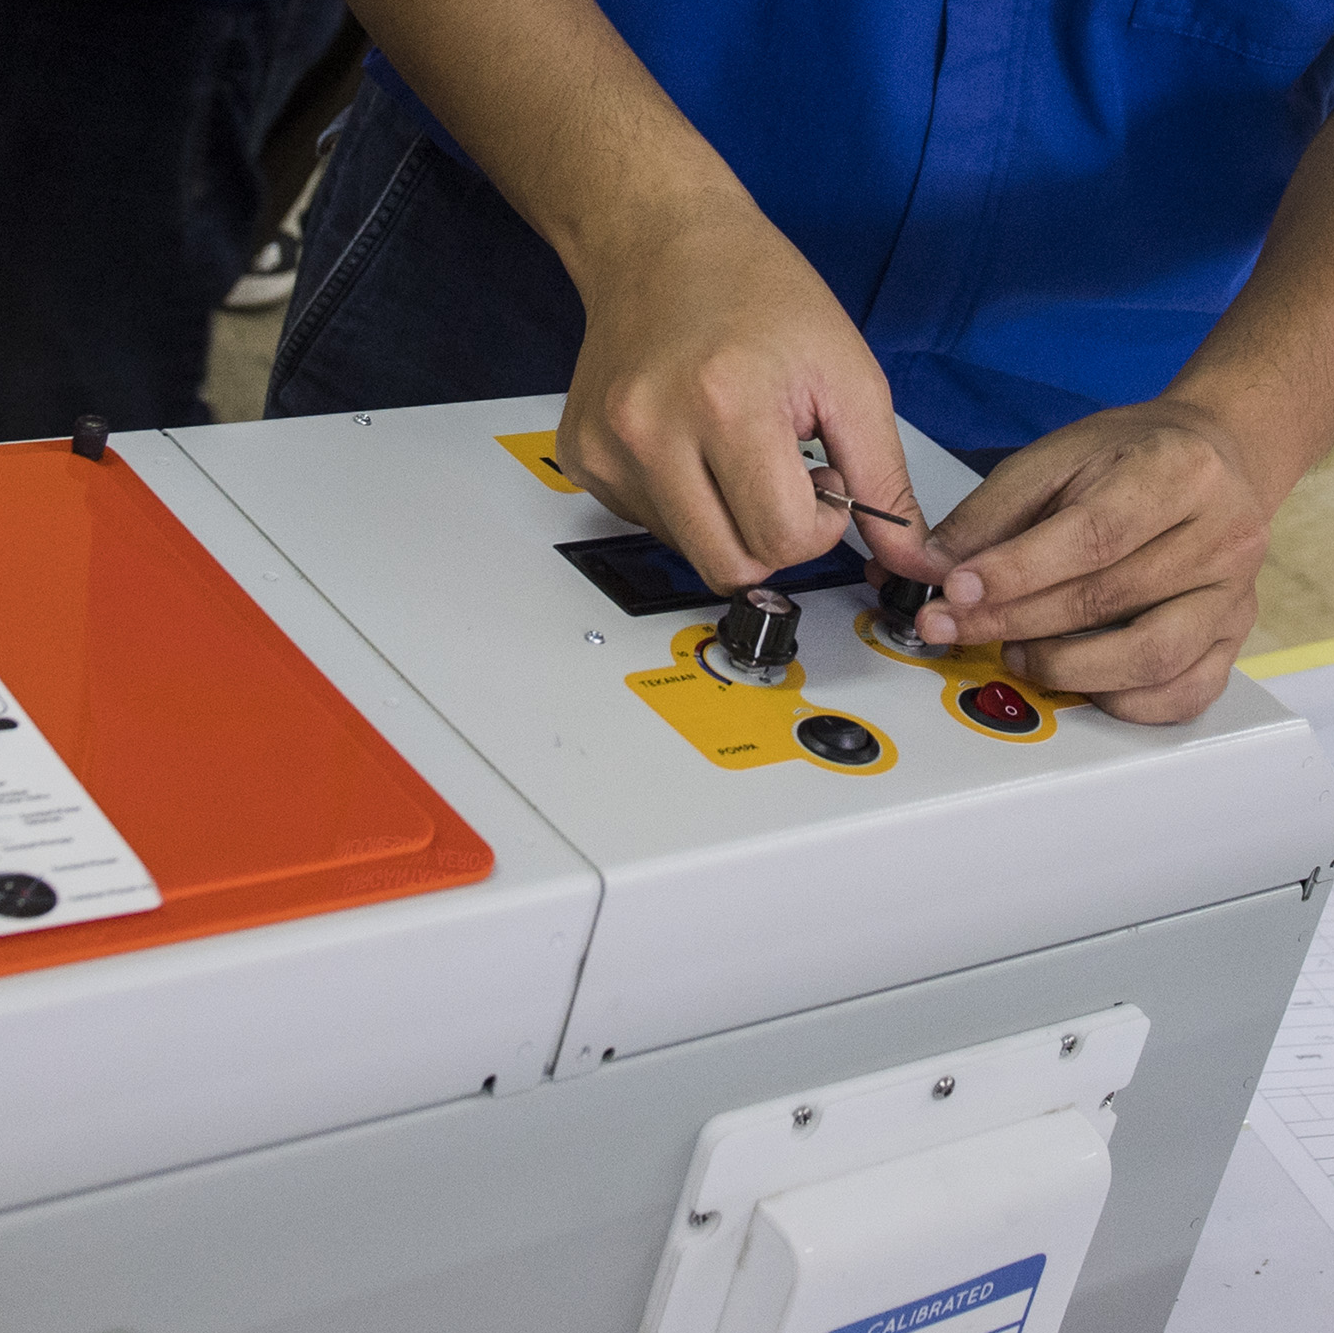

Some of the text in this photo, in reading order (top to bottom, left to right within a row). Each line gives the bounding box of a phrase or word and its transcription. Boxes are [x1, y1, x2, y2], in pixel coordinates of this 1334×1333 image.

[640, 674, 696, 688] TEKANAN
[718, 743, 758, 755] POMPA
[867, 1281, 994, 1333] CALIBRATED
